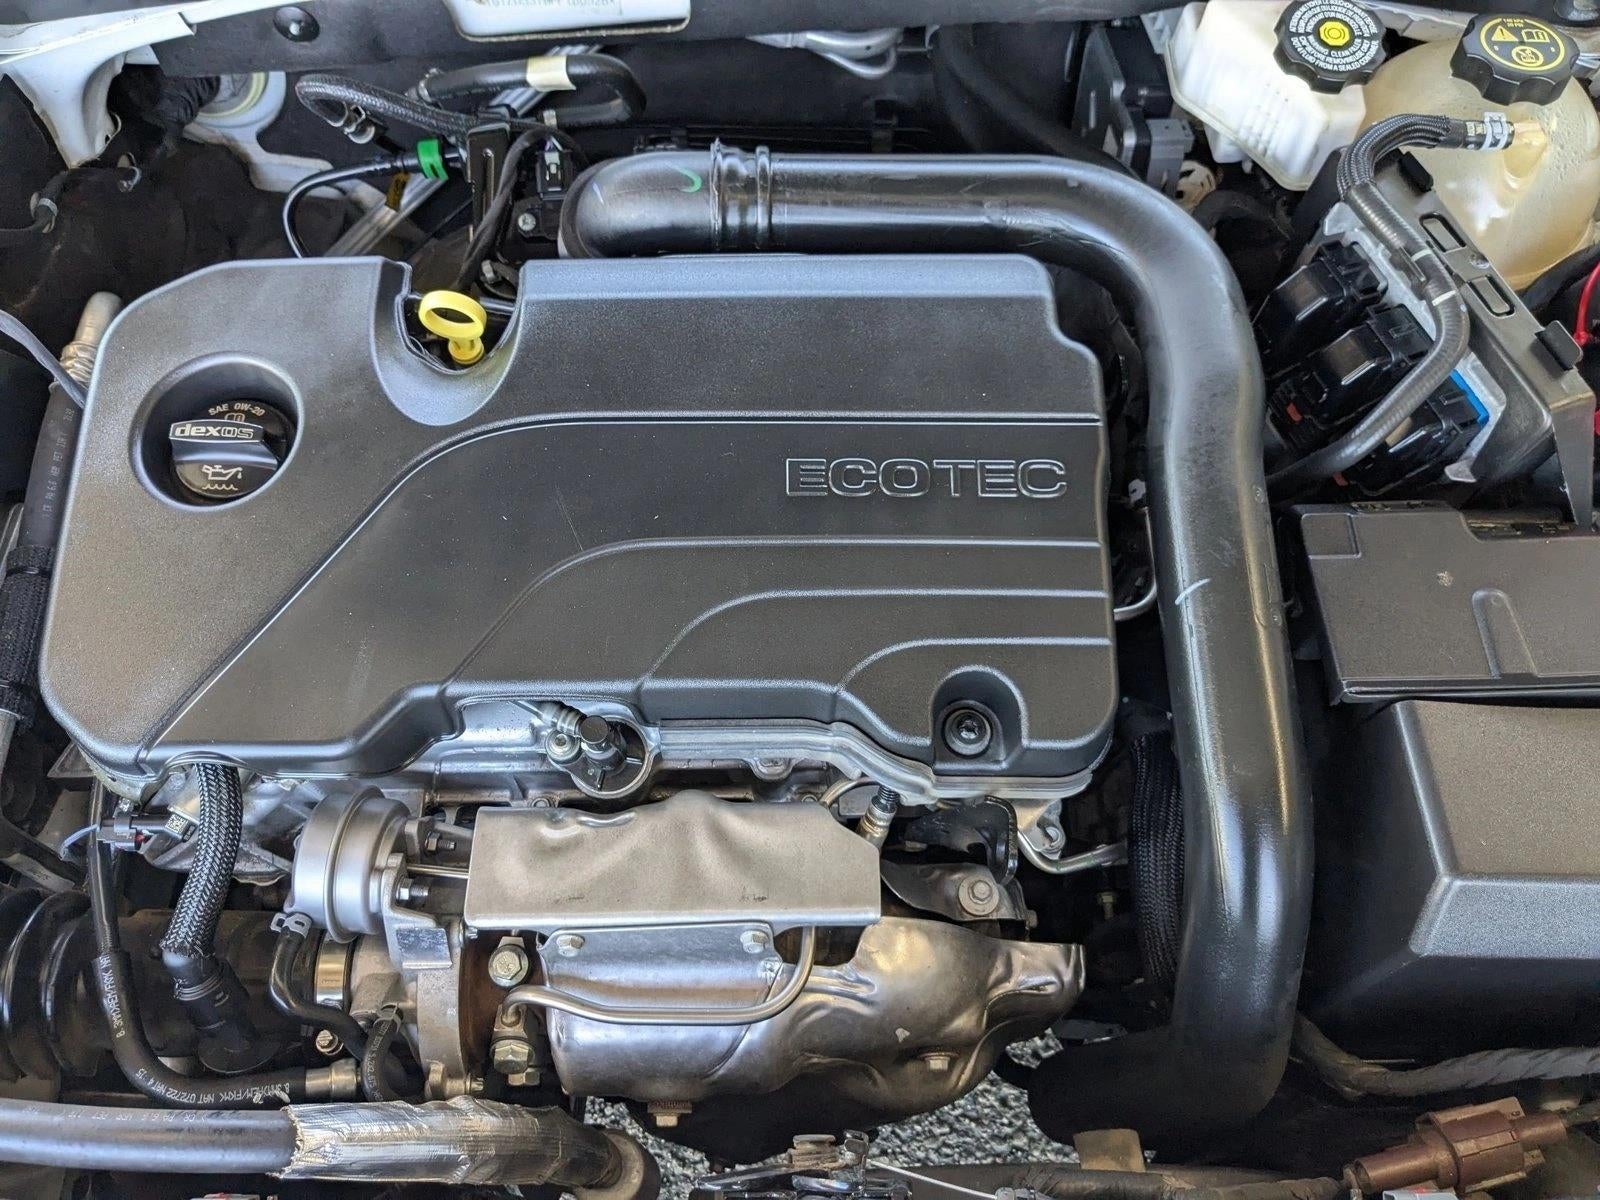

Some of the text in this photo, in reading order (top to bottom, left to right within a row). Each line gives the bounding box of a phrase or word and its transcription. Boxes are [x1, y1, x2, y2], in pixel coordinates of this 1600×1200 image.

[208, 402, 266, 417] SAE 0W-20
[175, 423, 254, 439] dexos
[786, 457, 1068, 499] ECOTEC
[151, 1080, 168, 1096] NAT
[166, 1087, 197, 1104] 072722
[197, 1093, 215, 1104] NAT
